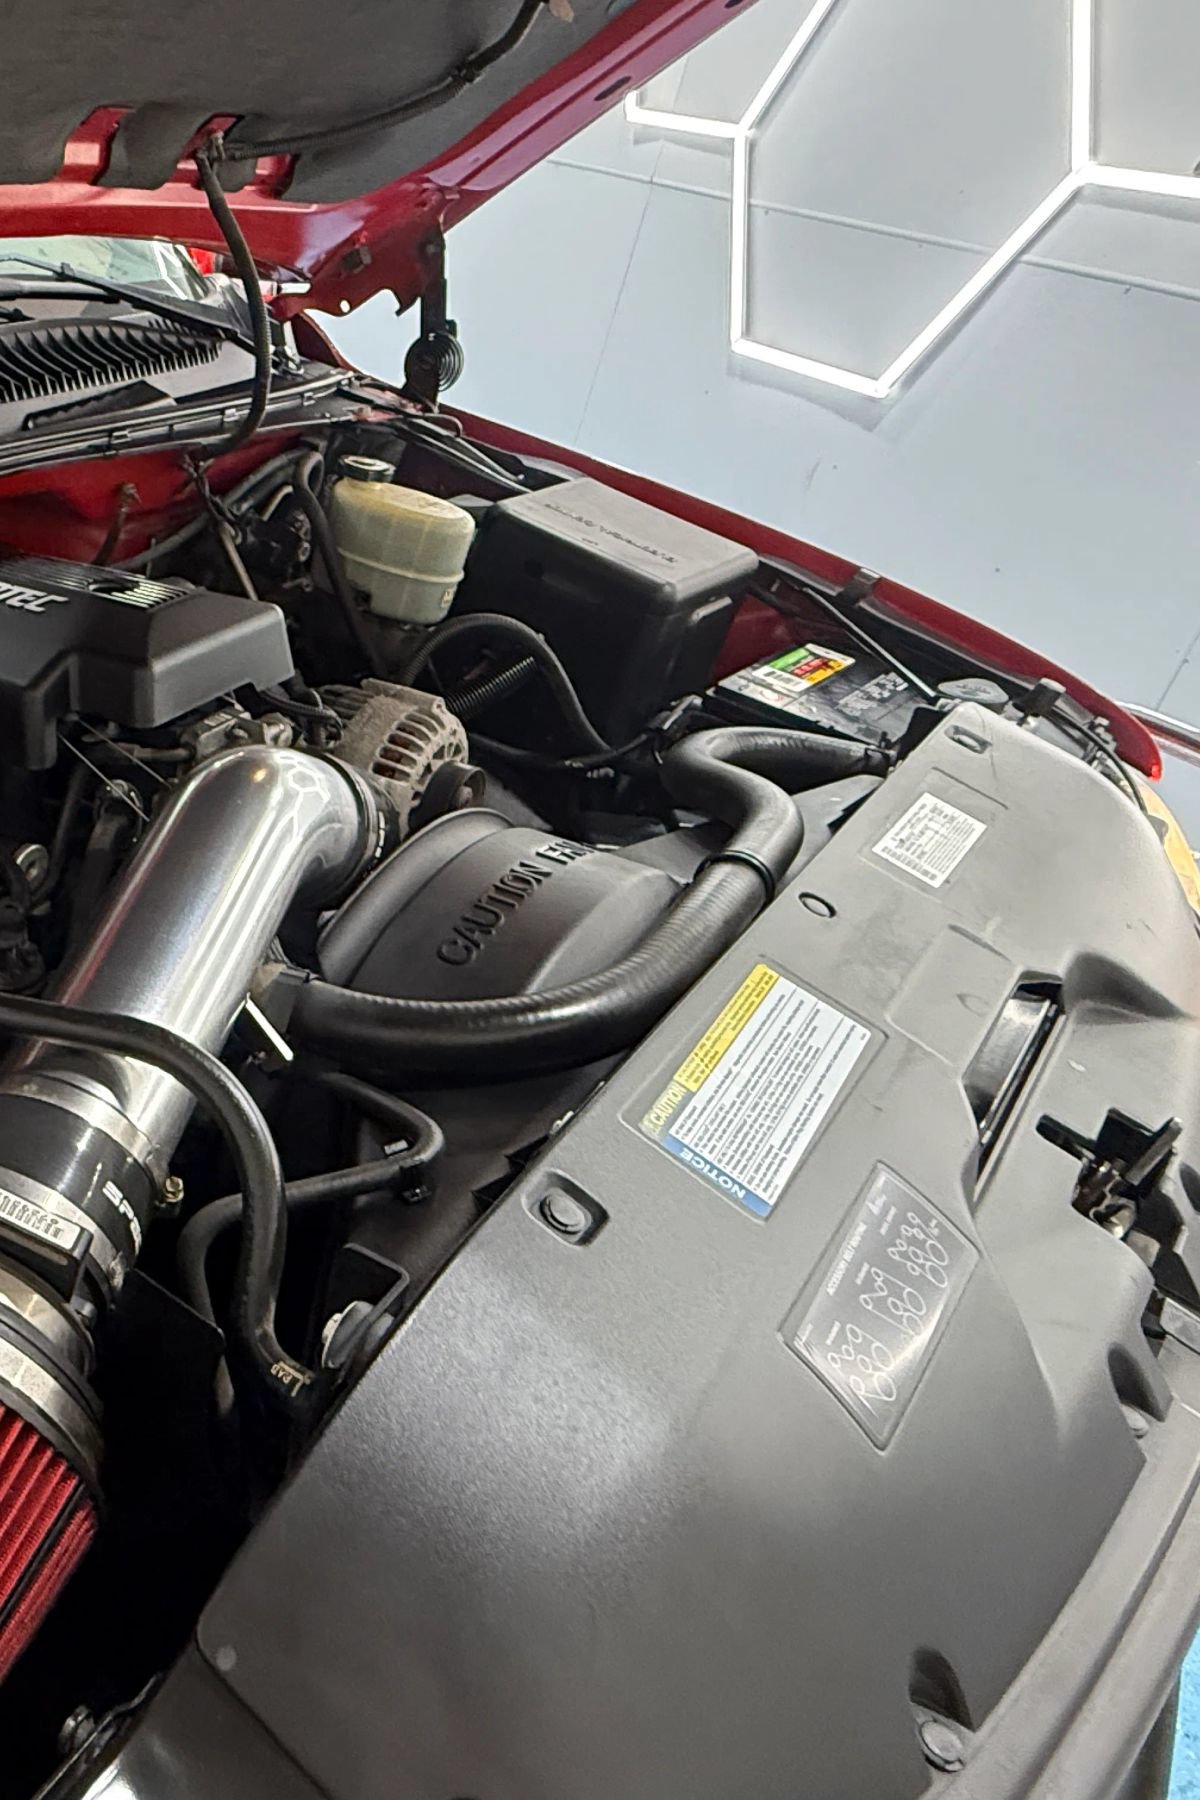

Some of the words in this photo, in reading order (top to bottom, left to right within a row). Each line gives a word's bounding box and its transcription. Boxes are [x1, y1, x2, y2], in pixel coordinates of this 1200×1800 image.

[436, 861, 553, 967] CAUTION
[649, 1079, 689, 1126] CAUTION
[679, 1147, 746, 1199] NOTICE
